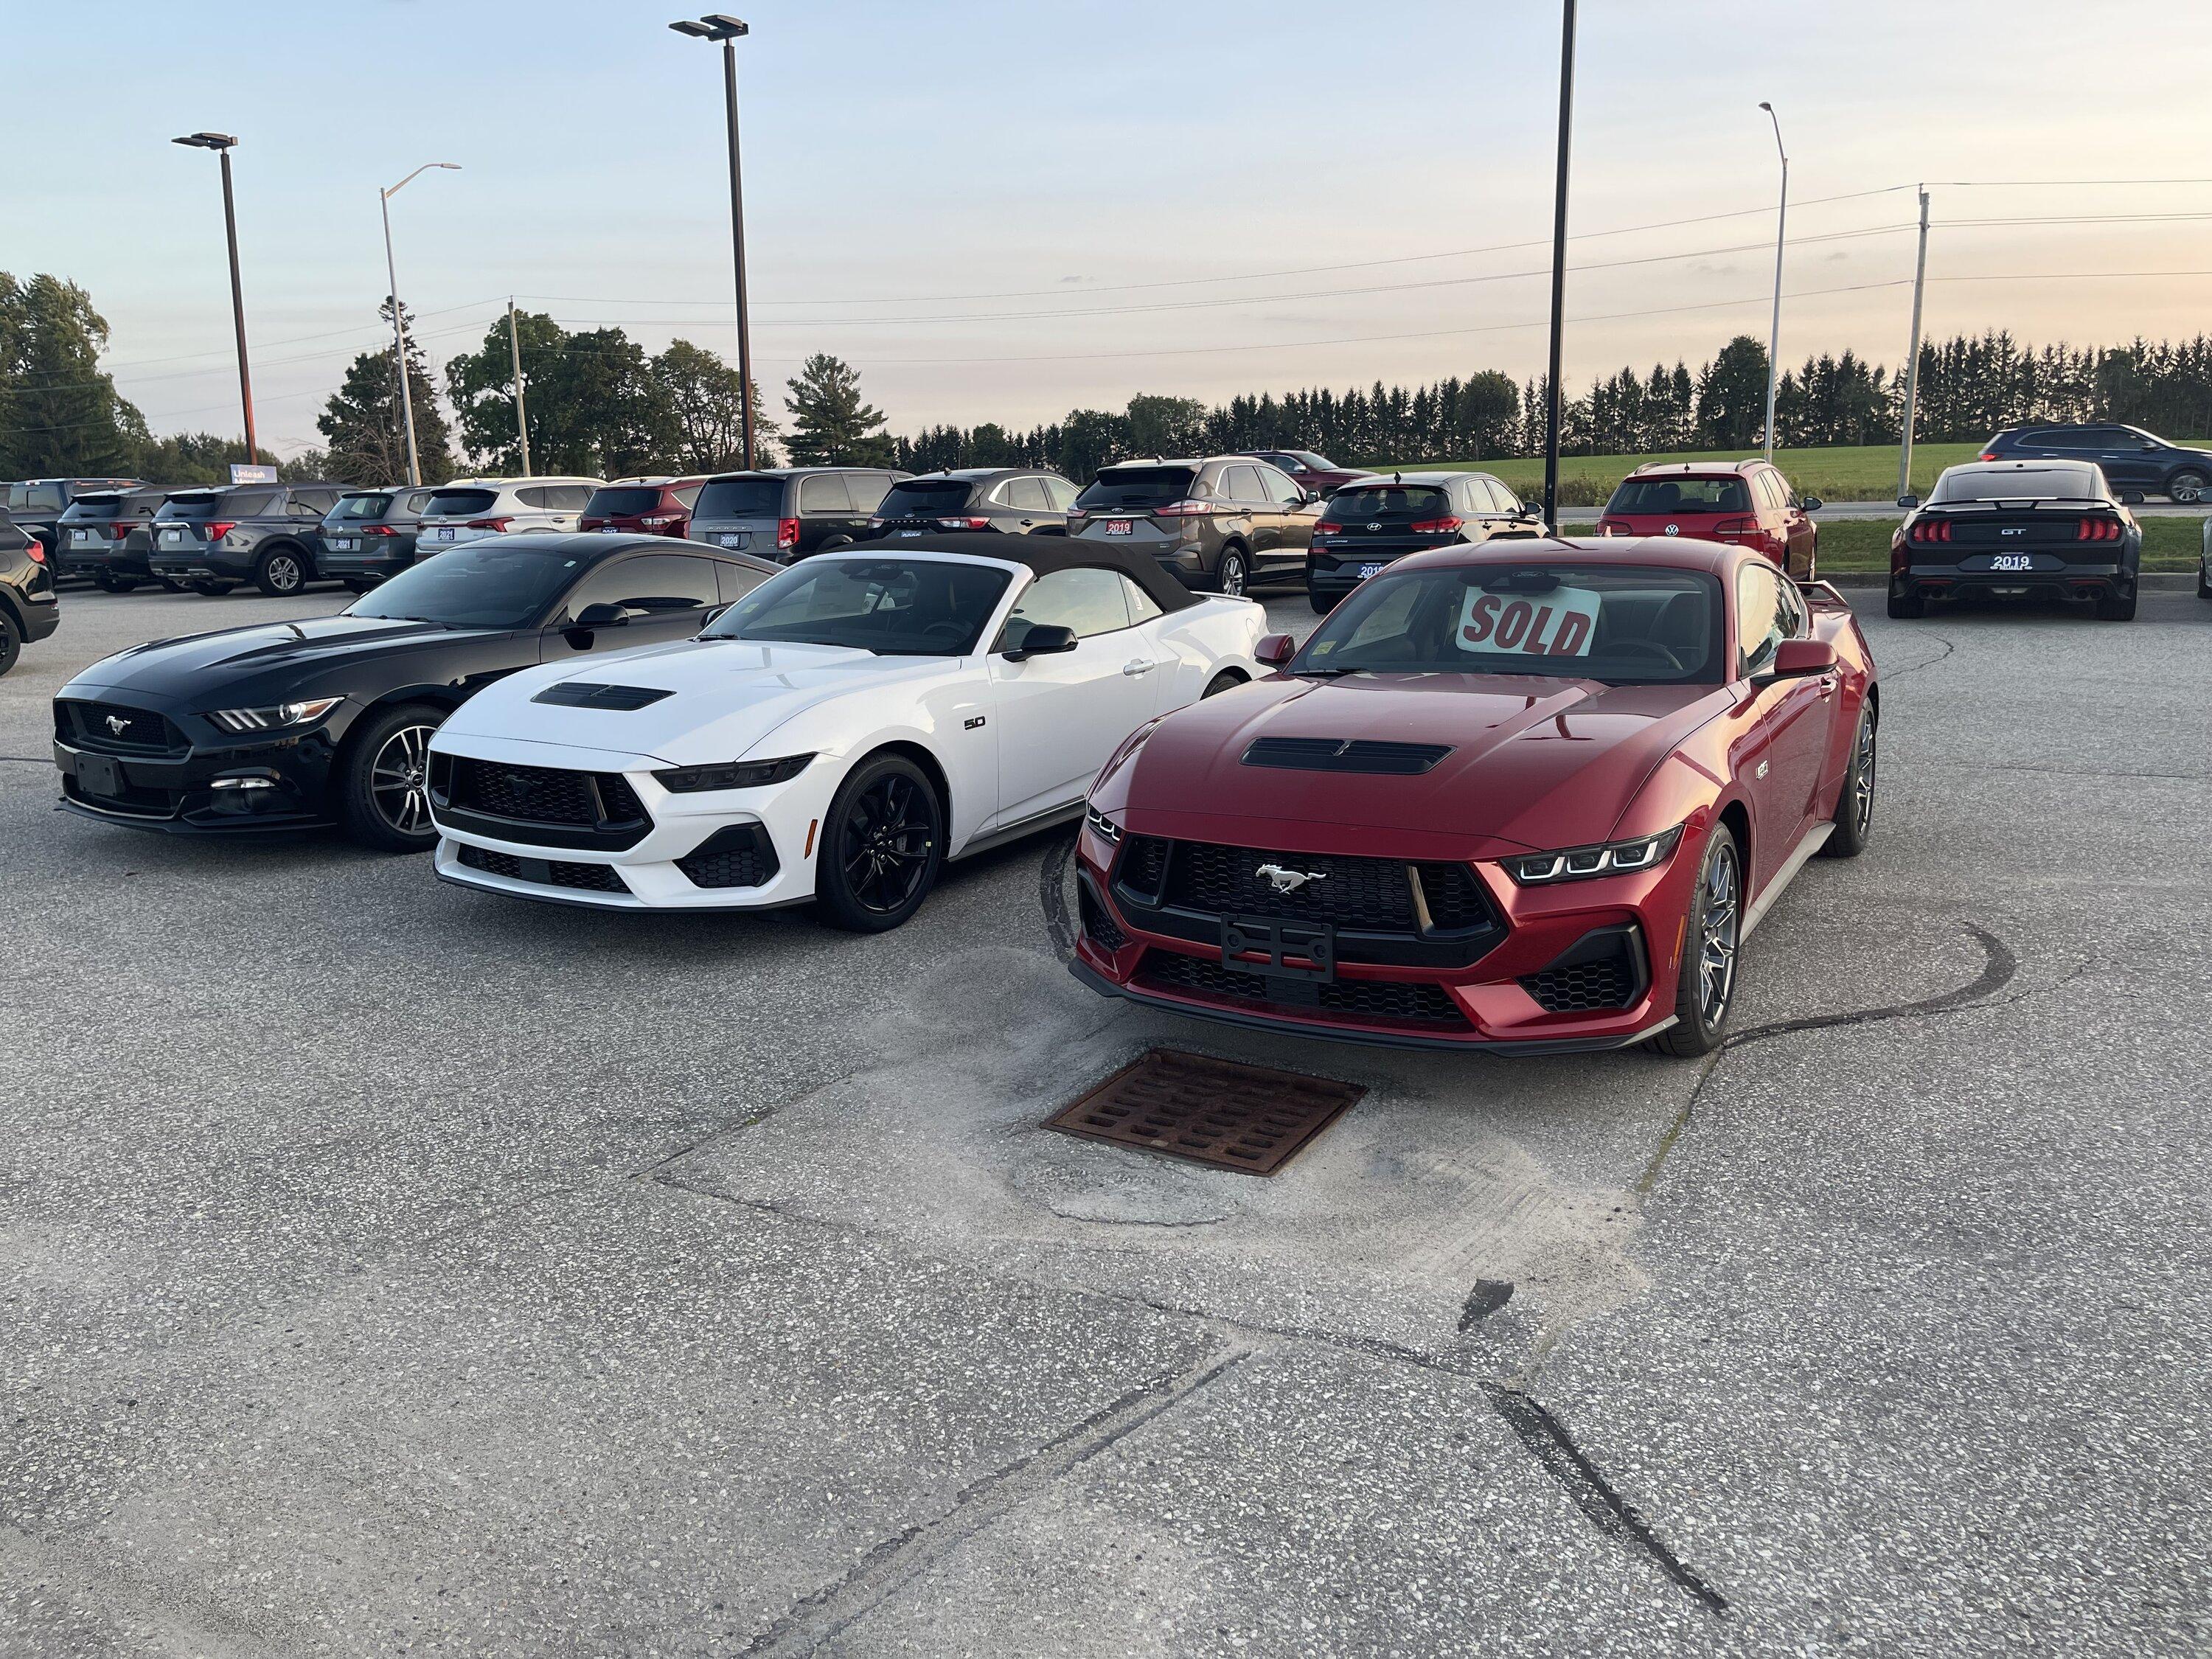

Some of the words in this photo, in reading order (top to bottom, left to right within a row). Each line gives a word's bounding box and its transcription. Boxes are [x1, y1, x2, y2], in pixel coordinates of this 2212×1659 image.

[234, 470, 265, 479] Unleash
[1108, 523, 1130, 532] 2019
[439, 530, 453, 539] 2021
[1994, 556, 2029, 566] 2019
[1463, 595, 1590, 656] SOLD
